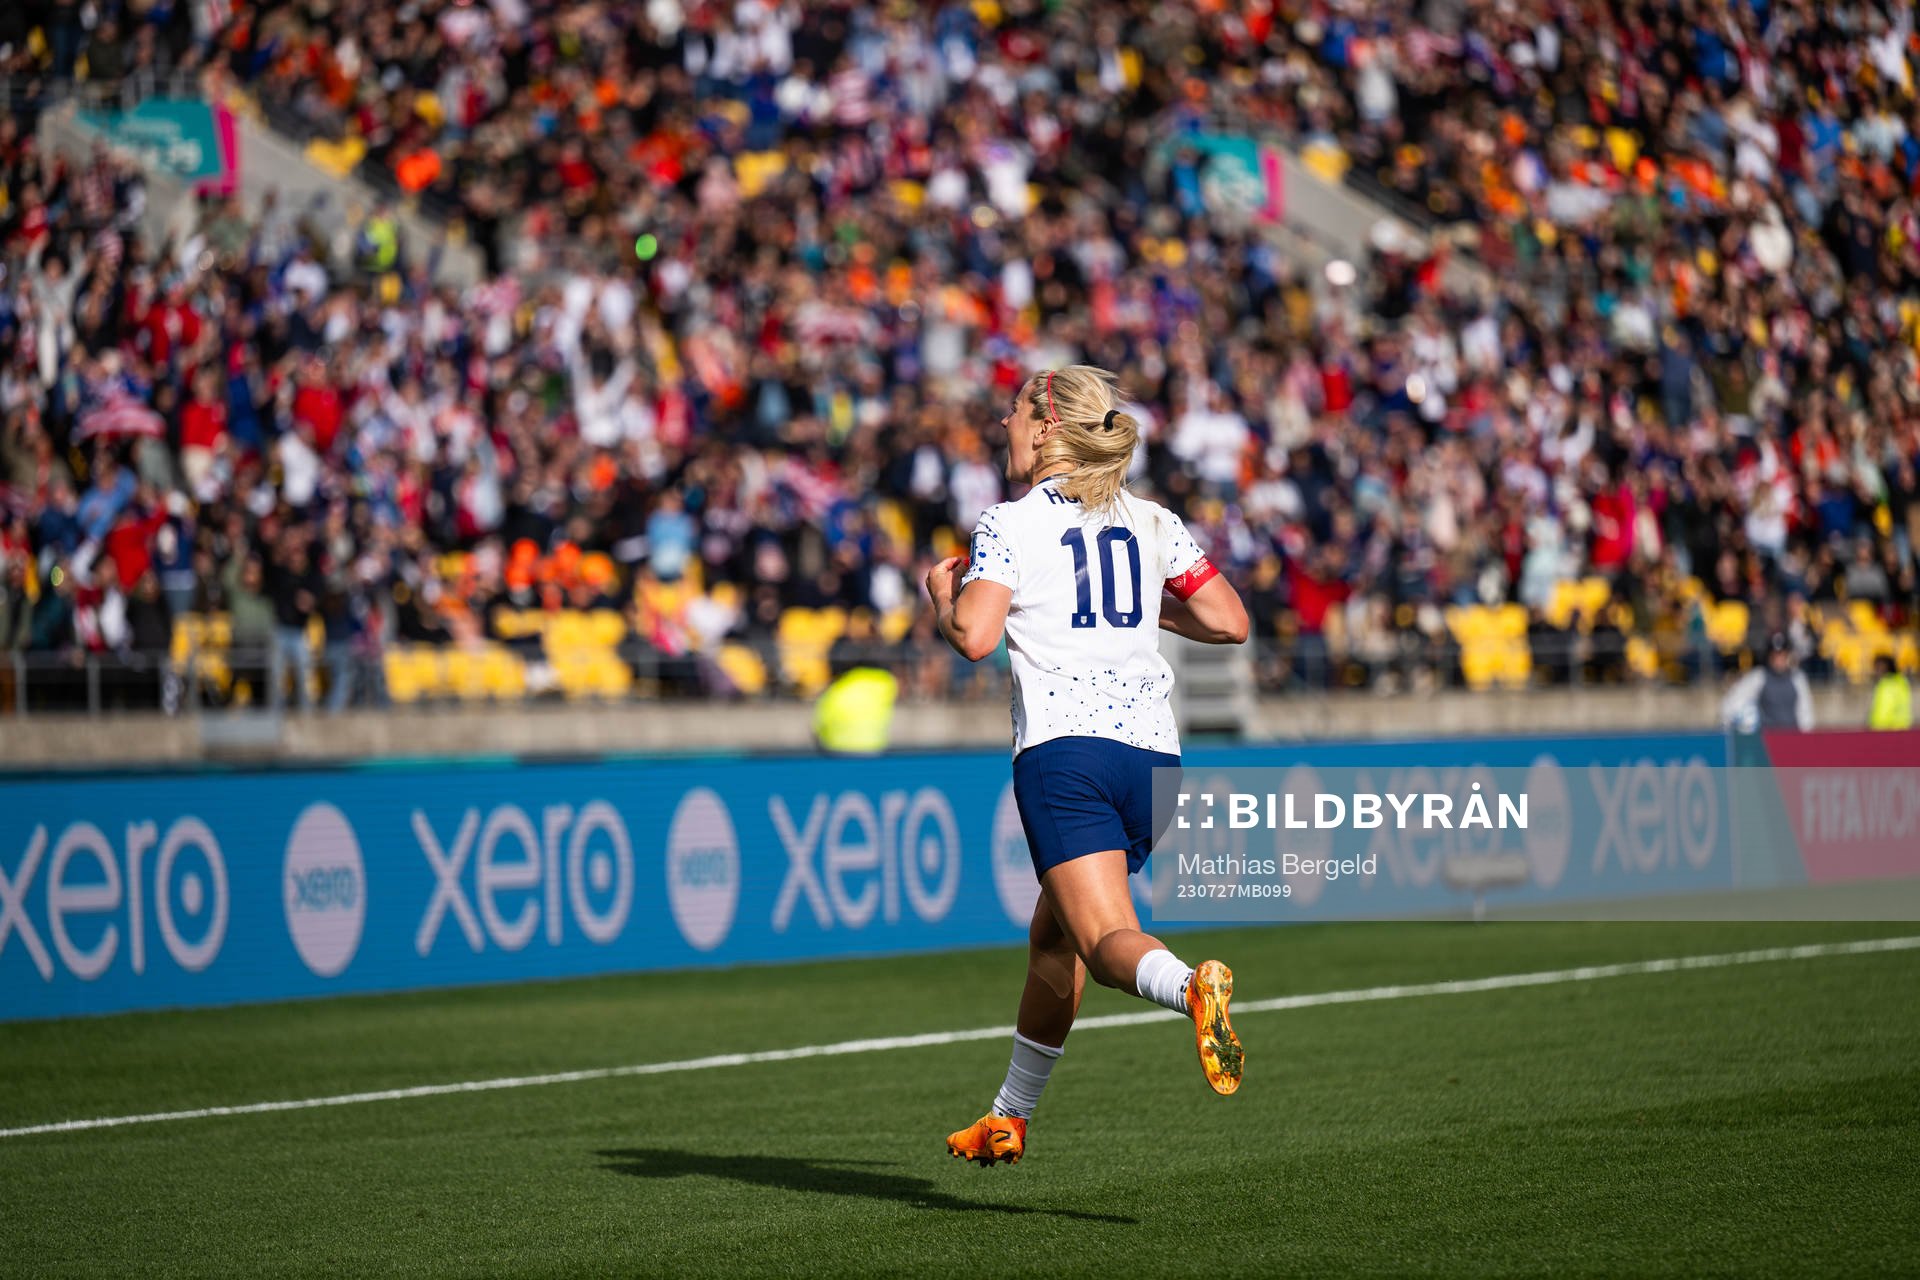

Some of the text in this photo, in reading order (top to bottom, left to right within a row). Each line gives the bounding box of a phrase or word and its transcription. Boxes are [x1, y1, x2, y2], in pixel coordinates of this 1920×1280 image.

[1060, 526, 1143, 629] 10
[768, 786, 962, 933] xero
[1588, 755, 1719, 876] xero
[1802, 774, 1863, 844] FIFA
[0, 815, 230, 983] xero
[411, 799, 635, 957] xero
